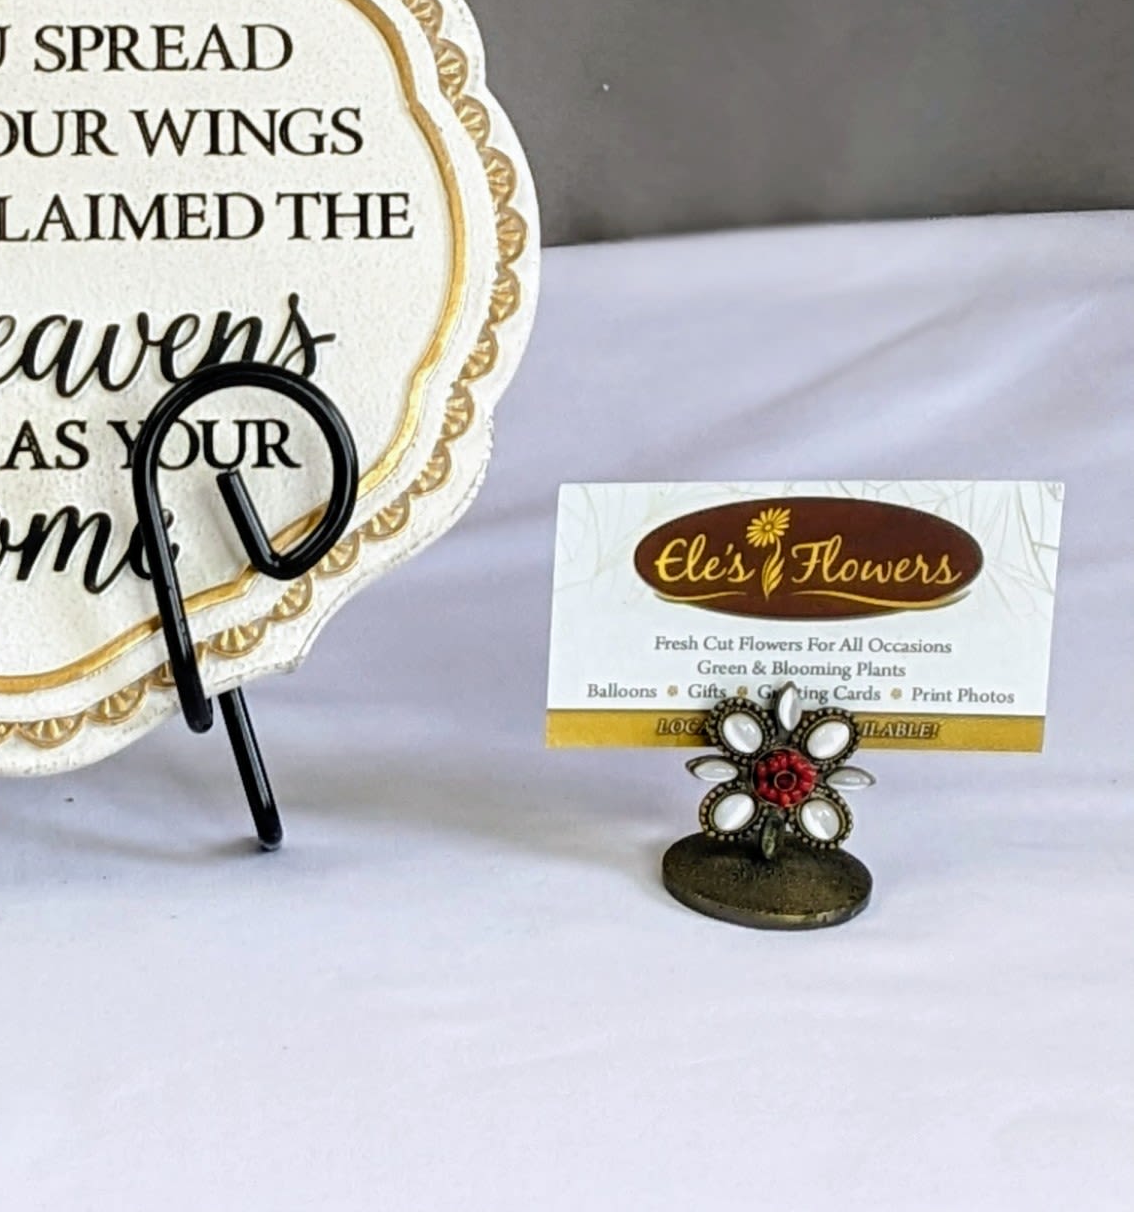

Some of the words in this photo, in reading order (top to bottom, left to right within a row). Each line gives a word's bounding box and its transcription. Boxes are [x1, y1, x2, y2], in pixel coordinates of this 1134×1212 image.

[33, 24, 294, 72] SPREAD
[129, 107, 364, 157] WINGS
[276, 192, 415, 241] THE
[0, 420, 91, 471] AS
[107, 418, 302, 471] YOUR
[654, 534, 755, 583] Ele's
[790, 534, 962, 585] Flowers
[654, 636, 699, 651] Fresh
[703, 636, 735, 652] Cut
[739, 637, 803, 653] Flowers
[807, 637, 835, 653] For
[838, 637, 864, 654] All
[868, 638, 952, 654] Occasions
[587, 684, 657, 698] Balloons
[688, 684, 726, 700] Gifts
[757, 683, 829, 705] Grting
[833, 685, 881, 702] Cards
[911, 687, 953, 703] Print
[957, 687, 1015, 704] Photos
[697, 660, 747, 675] Green
[751, 660, 767, 676] &
[771, 661, 852, 681] Blooming
[856, 662, 906, 678] Plants
